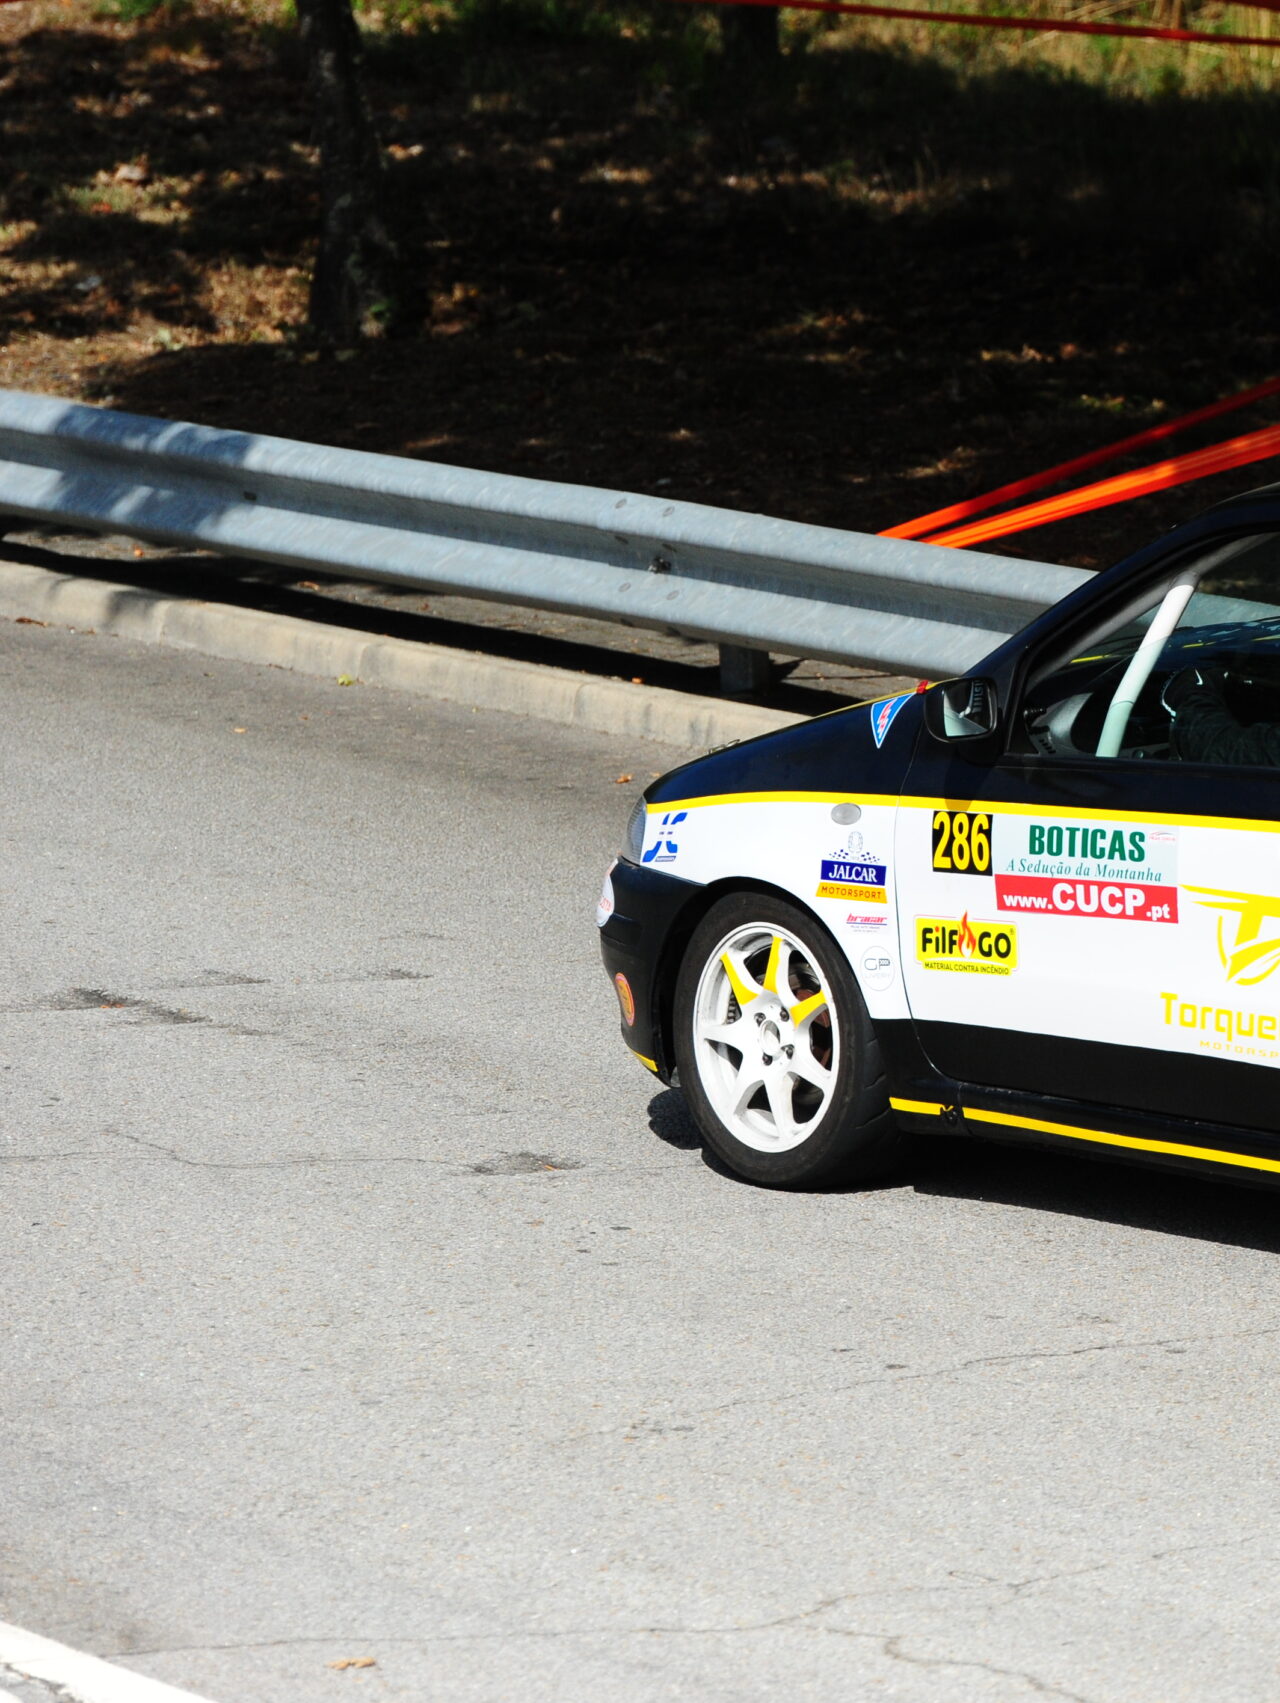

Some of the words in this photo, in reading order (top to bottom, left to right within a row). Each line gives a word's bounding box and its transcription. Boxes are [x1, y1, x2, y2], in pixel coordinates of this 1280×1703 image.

[933, 811, 990, 872] 286
[1029, 824, 1146, 863] BOTICAS
[828, 864, 878, 883] JALCAR
[1006, 858, 1016, 872] A
[1018, 858, 1071, 879] Sedução
[1075, 861, 1090, 876] da
[1093, 864, 1162, 883] Montanha
[821, 886, 882, 900] MOTORSPORT
[1002, 882, 1171, 922] www.CUCP.pt
[924, 962, 953, 971] MATERIAL
[954, 965, 979, 973] CONTRA
[980, 966, 1010, 975] INCÊNDIO
